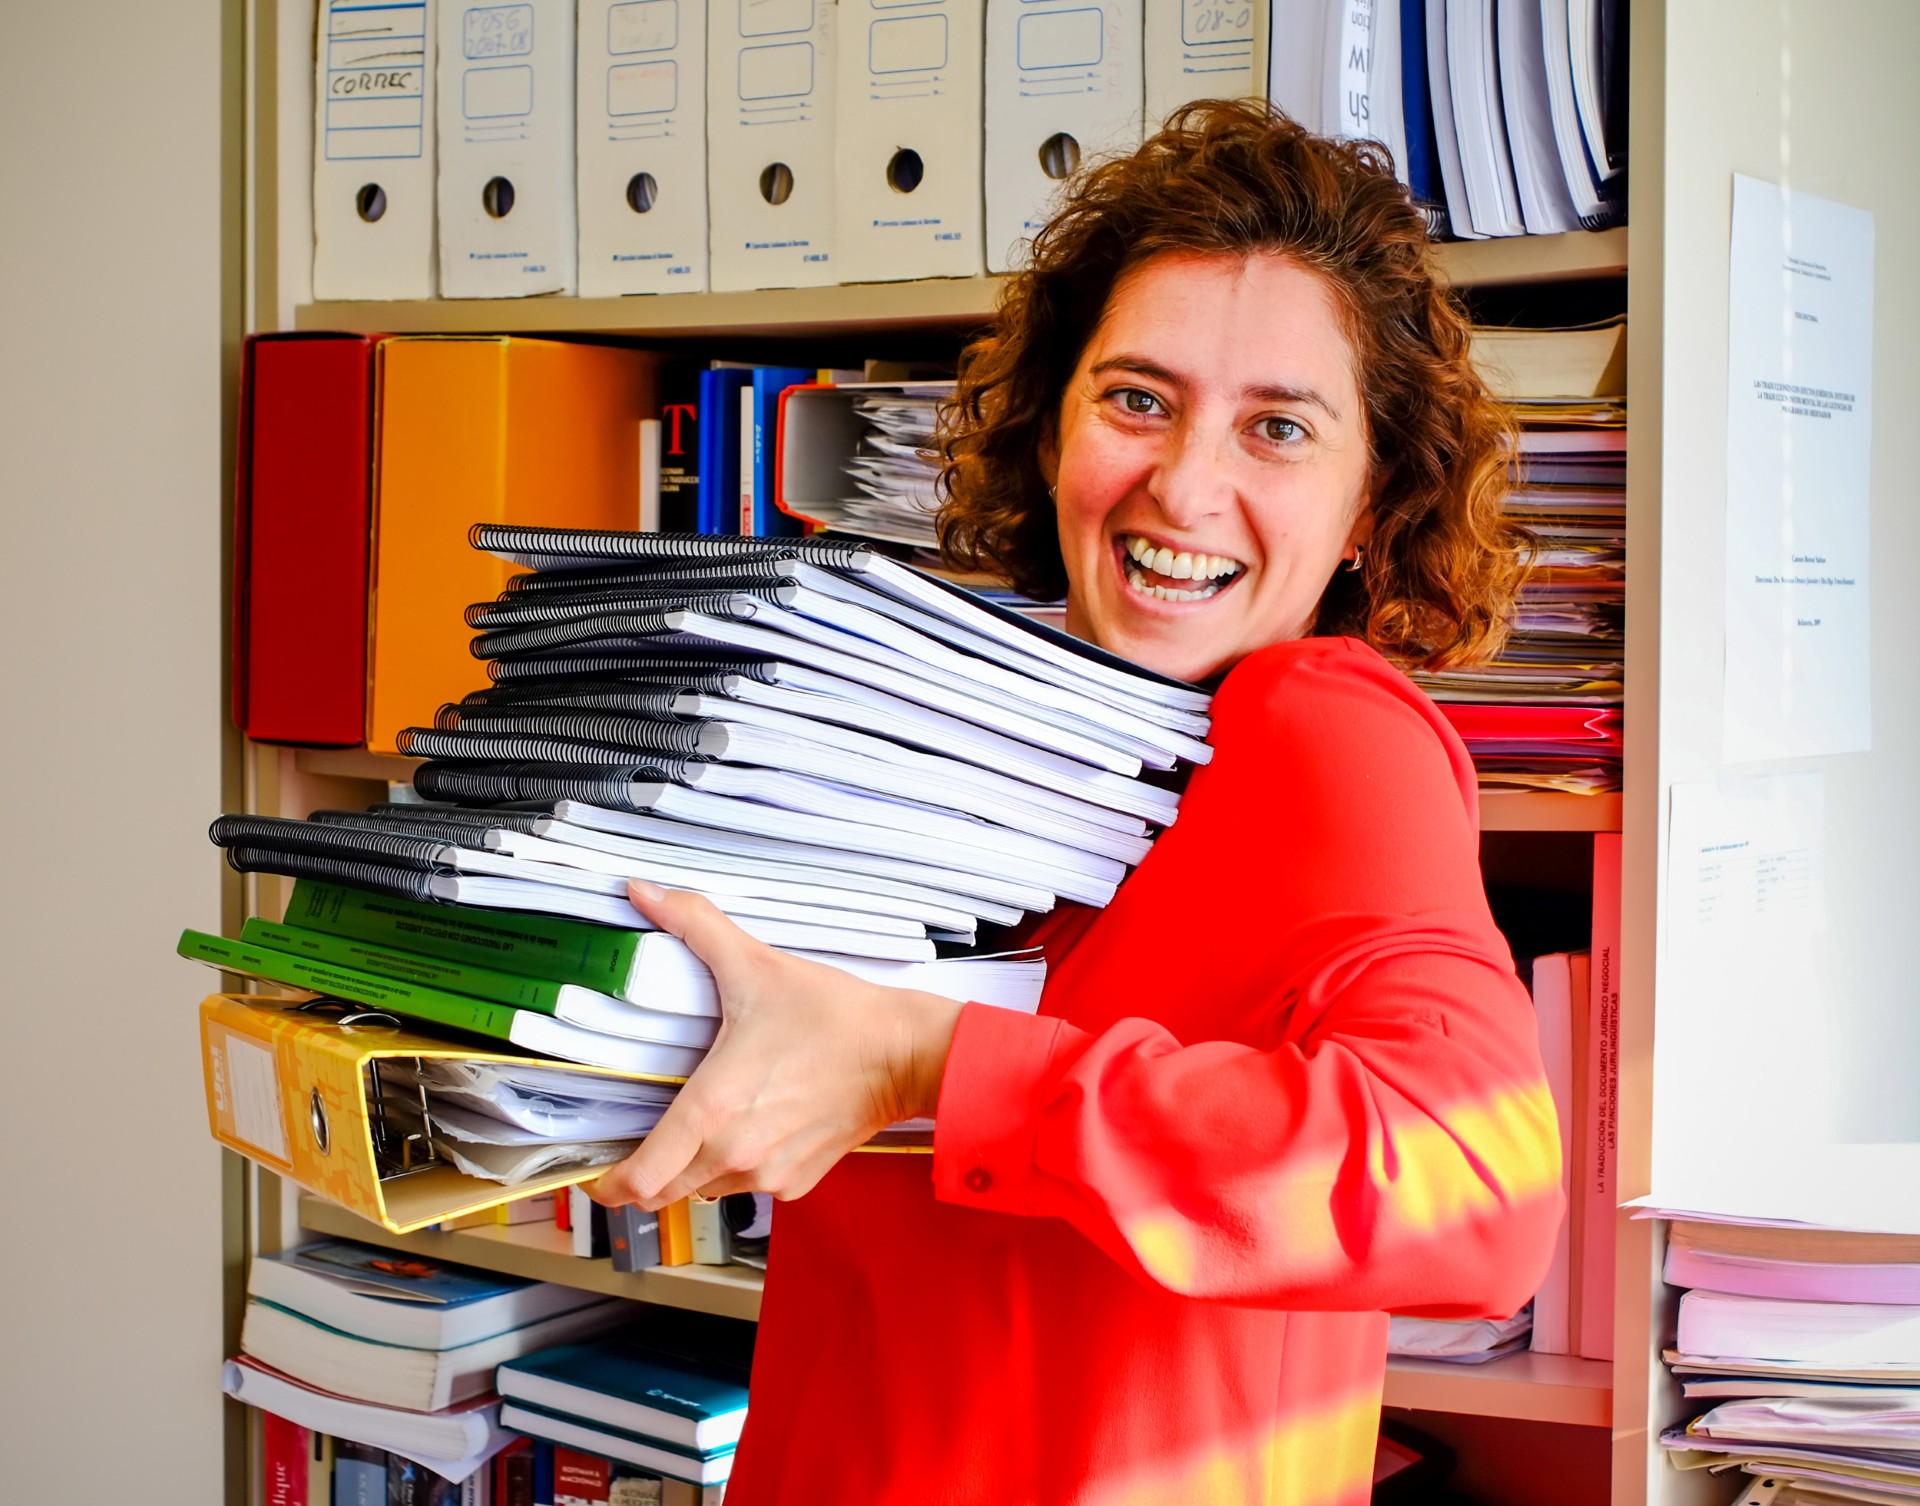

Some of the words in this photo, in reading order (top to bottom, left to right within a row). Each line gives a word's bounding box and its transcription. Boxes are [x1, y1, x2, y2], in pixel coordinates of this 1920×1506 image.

[663, 403, 697, 456] T
[1601, 947, 1610, 993] NEGOCIAL
[1599, 1040, 1608, 1097] DOCUMENTO
[1599, 1099, 1607, 1117] DEL
[1608, 1077, 1616, 1129] FUNCIONES
[1597, 1181, 1604, 1193] LA
